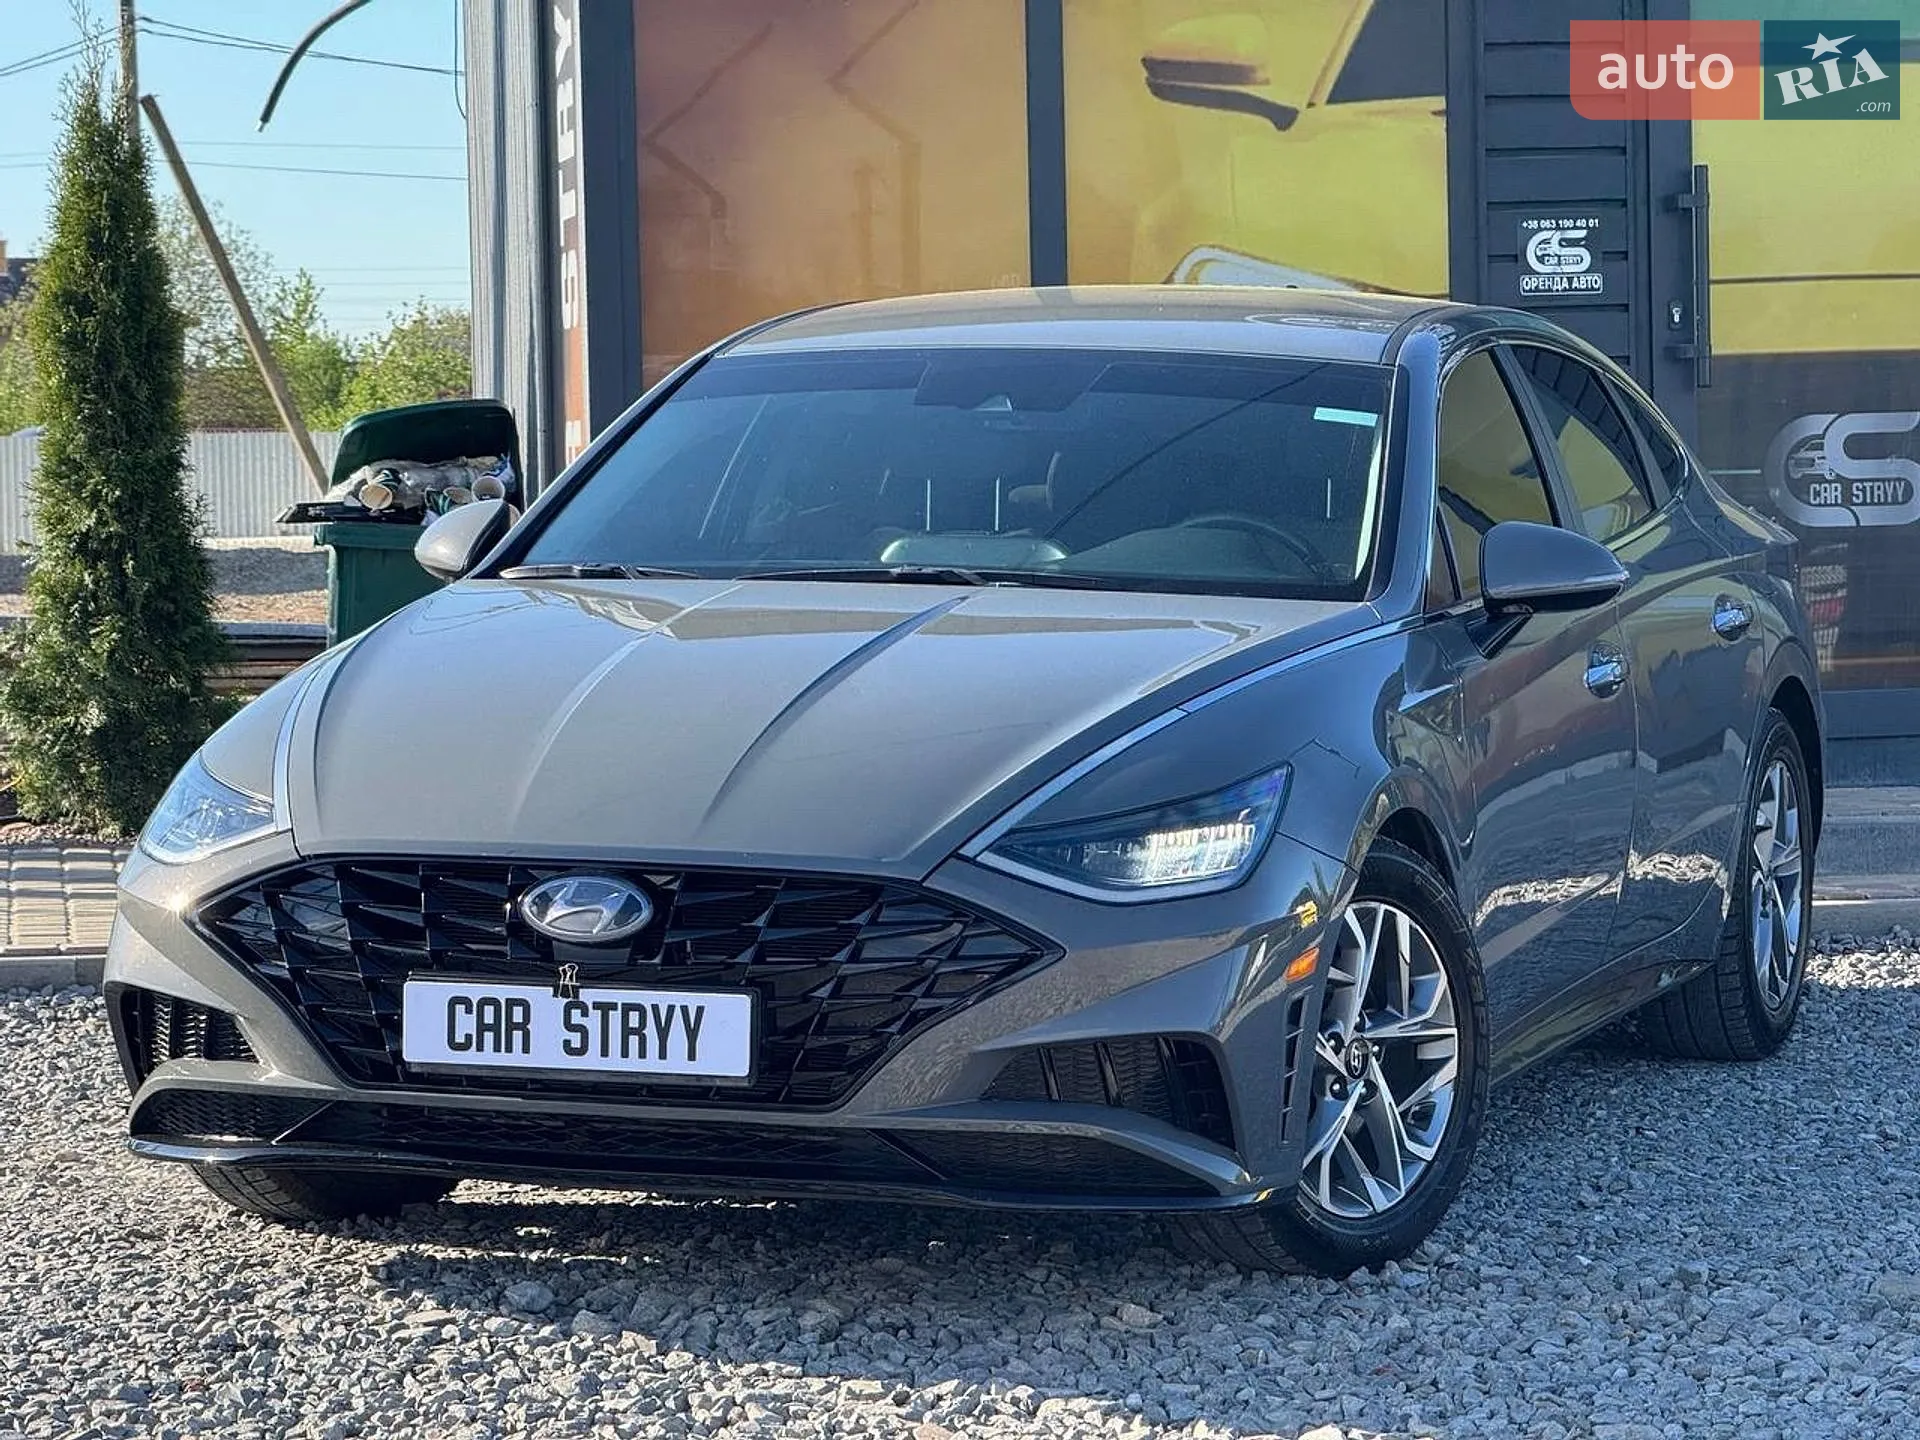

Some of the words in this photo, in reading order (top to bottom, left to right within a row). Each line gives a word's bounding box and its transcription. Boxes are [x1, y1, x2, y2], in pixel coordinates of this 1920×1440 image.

[1588, 218, 1599, 228] 01
[1522, 277, 1569, 291] ОРЕНДА
[1571, 275, 1601, 289] АВТО
[1809, 483, 1842, 505] CAR
[1852, 480, 1905, 504] STRYY
[447, 995, 531, 1054] CAR
[562, 1000, 706, 1062] STRYY
